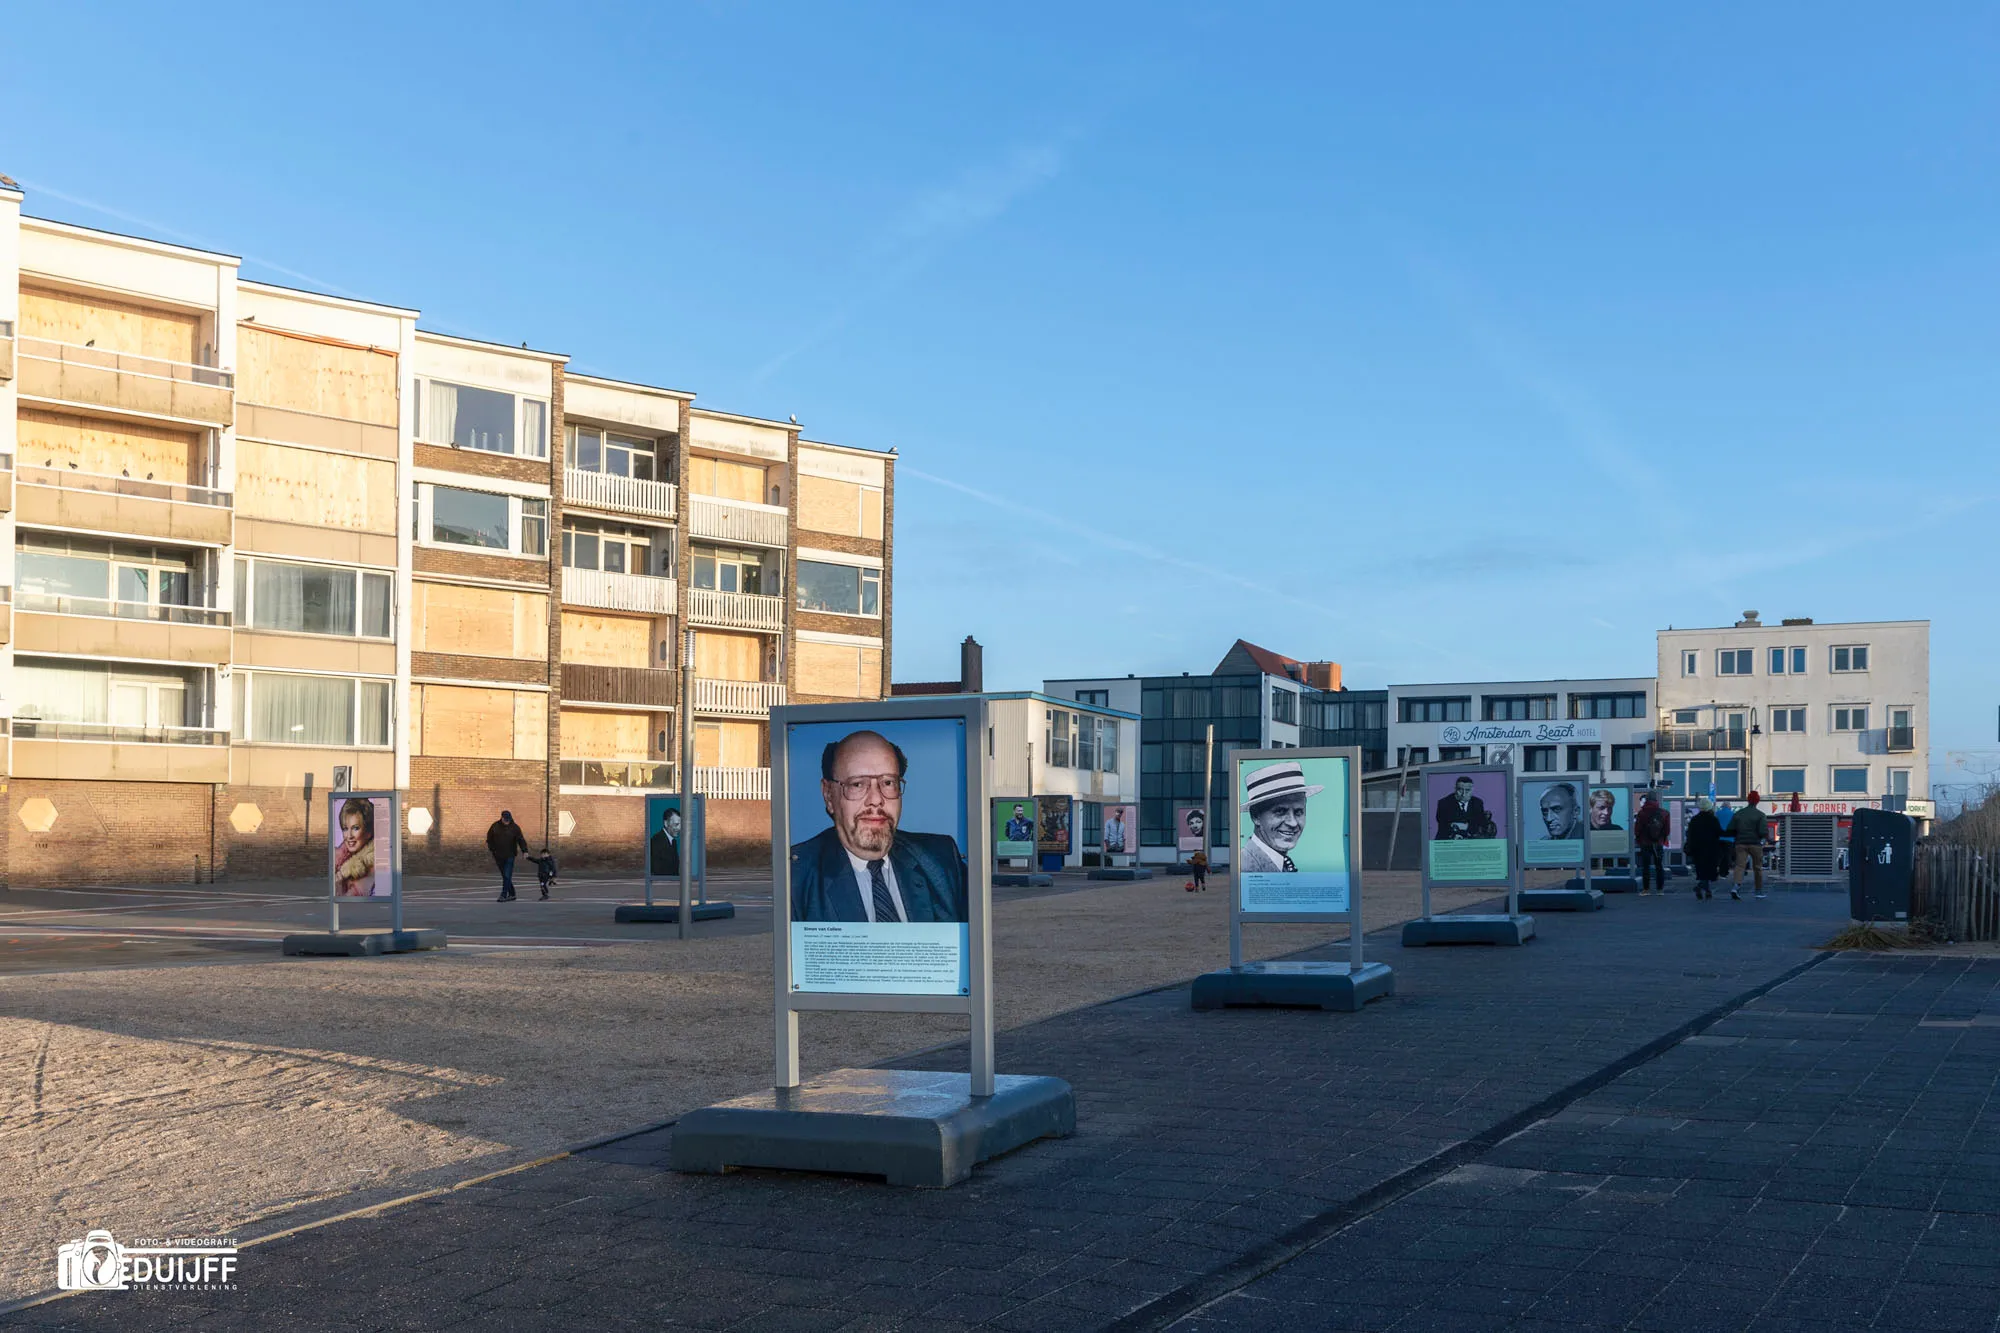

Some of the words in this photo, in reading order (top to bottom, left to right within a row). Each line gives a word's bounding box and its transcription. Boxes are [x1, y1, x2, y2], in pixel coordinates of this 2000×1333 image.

[1463, 725, 1532, 742] Amsterdam
[1536, 723, 1575, 741] Beach
[1577, 728, 1597, 737] HOTEL
[1782, 803, 1809, 813] TATY
[1813, 803, 1847, 813] CORNER
